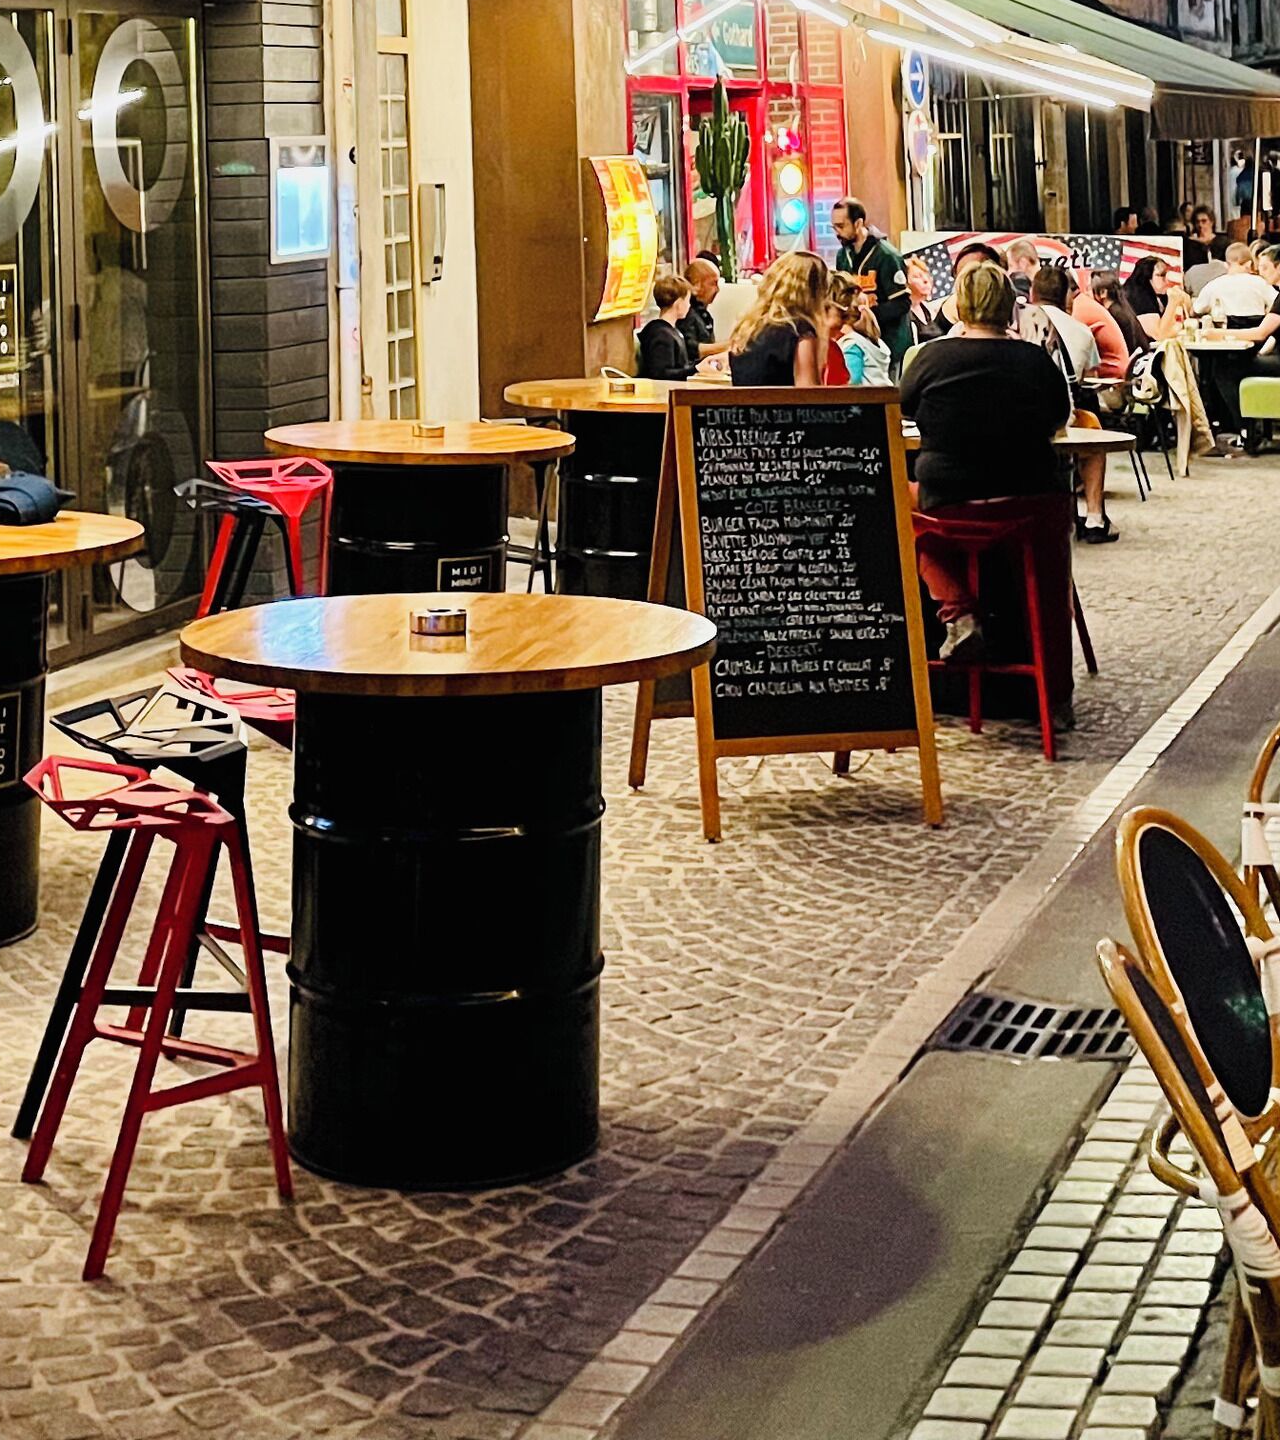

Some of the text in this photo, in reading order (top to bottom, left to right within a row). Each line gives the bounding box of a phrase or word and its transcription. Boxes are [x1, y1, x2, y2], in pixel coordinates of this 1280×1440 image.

[701, 515, 746, 533] BURGER
[702, 533, 748, 549] BAVETTE
[451, 565, 483, 577] MIDI
